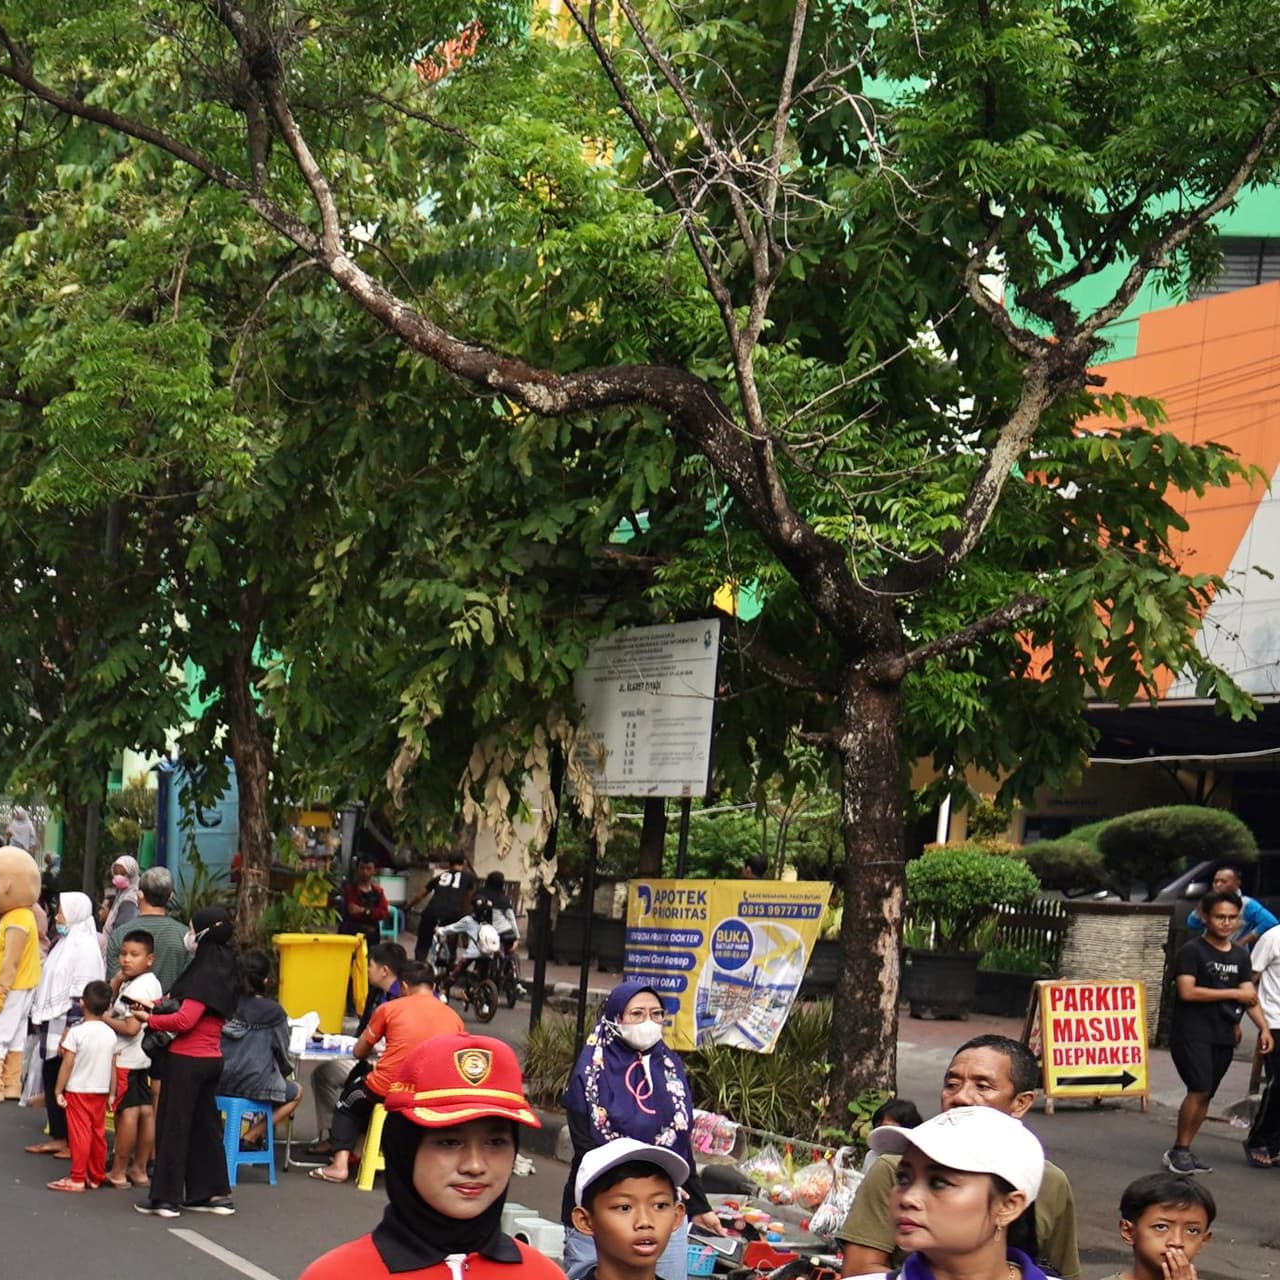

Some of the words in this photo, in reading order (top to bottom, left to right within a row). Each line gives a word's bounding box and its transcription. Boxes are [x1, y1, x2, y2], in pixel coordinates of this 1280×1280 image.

[439, 872, 461, 888] 91
[654, 890, 707, 905] APOTEK
[653, 906, 707, 920] PRIORITAS
[741, 905, 764, 915] 0813
[801, 907, 816, 916] 911
[670, 933, 699, 943] DOKTER
[716, 930, 749, 942] BUKA
[1050, 986, 1136, 1011] PARKIR
[1053, 1017, 1138, 1042] MASUK
[1053, 1046, 1141, 1066] DEPNAKER
